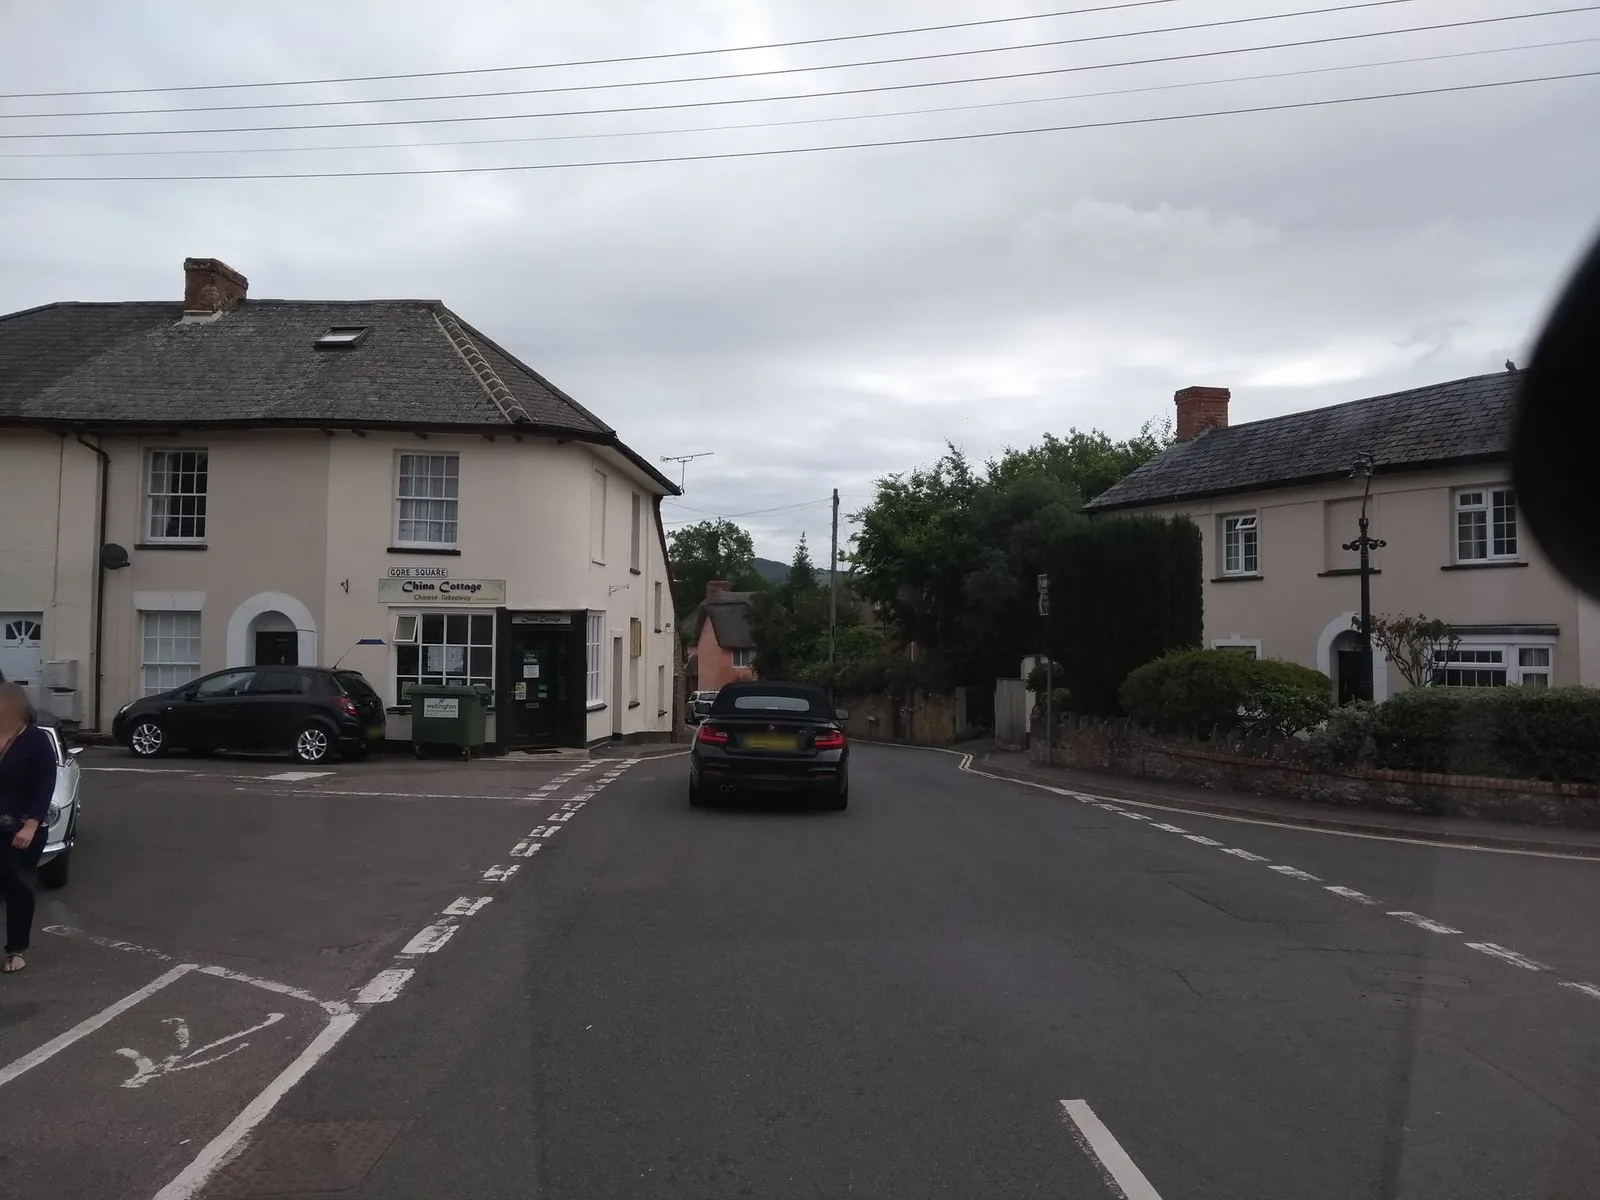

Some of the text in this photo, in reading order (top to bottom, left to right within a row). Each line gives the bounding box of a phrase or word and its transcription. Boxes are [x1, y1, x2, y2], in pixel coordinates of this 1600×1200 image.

[390, 568, 446, 576] GORE SQUARE
[402, 581, 482, 592] China Cottage
[441, 594, 472, 602] Takeaway
